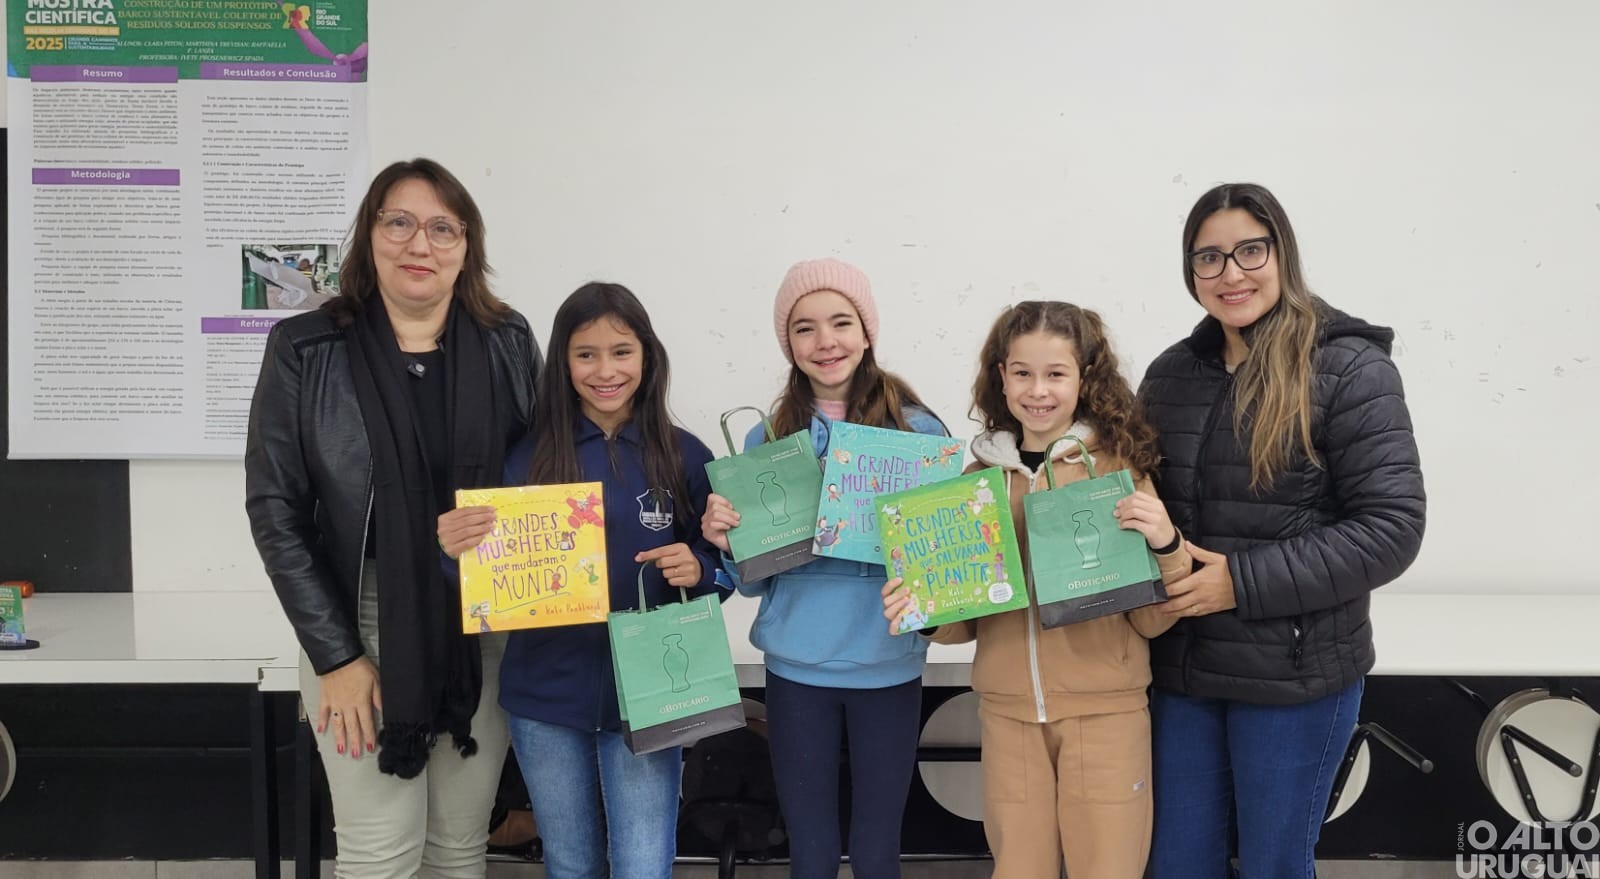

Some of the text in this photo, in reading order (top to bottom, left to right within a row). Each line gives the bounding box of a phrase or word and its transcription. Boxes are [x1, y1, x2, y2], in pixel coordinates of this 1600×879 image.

[27, 0, 114, 9] MOSTRA
[191, 1, 204, 9] DE
[206, 1, 222, 9] UM
[25, 8, 117, 24] CIENTÍFICA
[223, 12, 268, 20] COLETOR
[218, 22, 272, 30] SUSPENSOS
[26, 37, 64, 51] 2025
[82, 68, 123, 78] Resumo
[223, 68, 337, 78] Resultados e Conclusão
[71, 170, 131, 180] Metodologia
[240, 319, 276, 328] Referên
[858, 454, 921, 478] GRANDES
[841, 473, 914, 495] MULHER
[490, 512, 558, 538] GRANDES
[476, 531, 577, 565] MULHERES
[491, 554, 567, 576] que mudaram o
[492, 565, 568, 607] MUNDO
